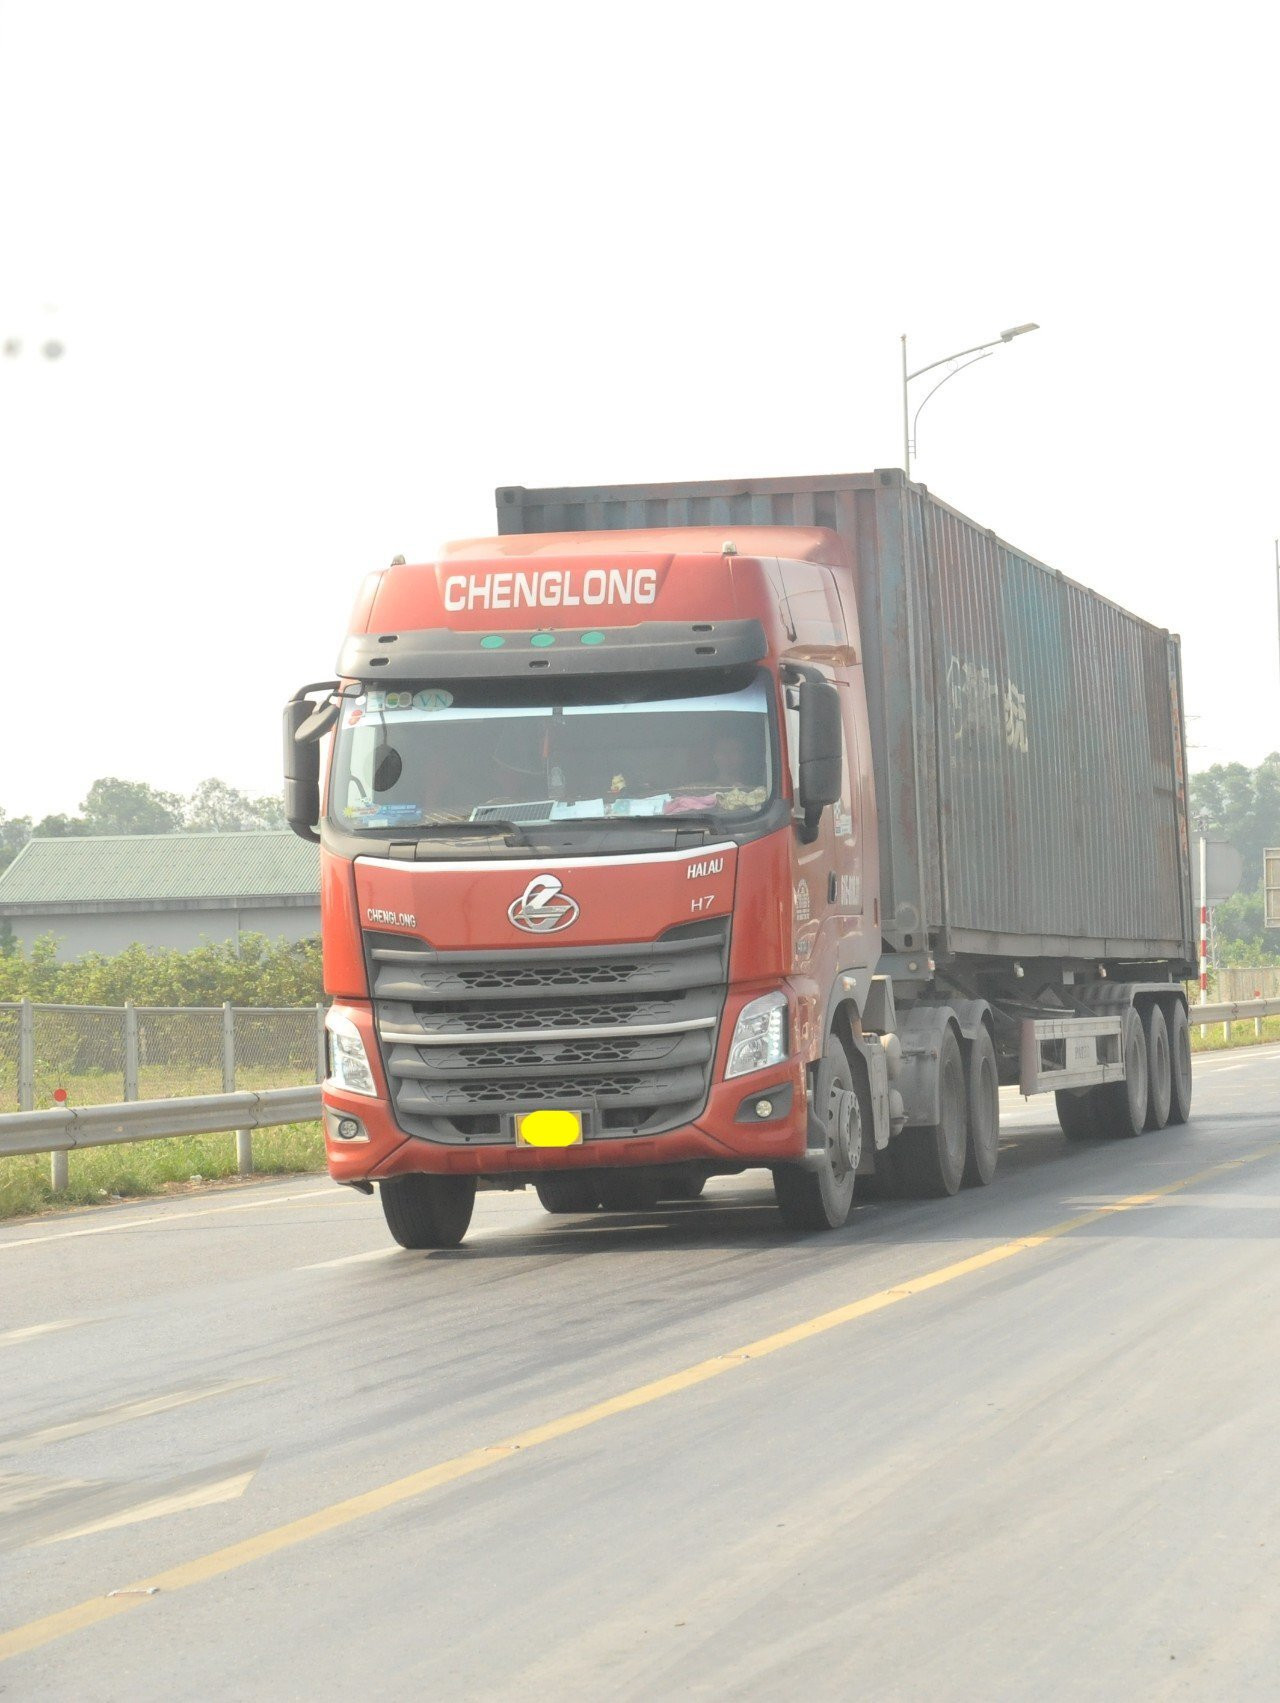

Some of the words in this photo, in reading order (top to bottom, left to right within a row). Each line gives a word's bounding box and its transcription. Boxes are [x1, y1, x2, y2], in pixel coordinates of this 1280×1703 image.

[443, 568, 658, 612] CHENGLONG
[419, 694, 448, 707] VN
[687, 857, 724, 880] HALAU
[691, 895, 715, 912] H7
[367, 908, 416, 927] CHENGLONG
